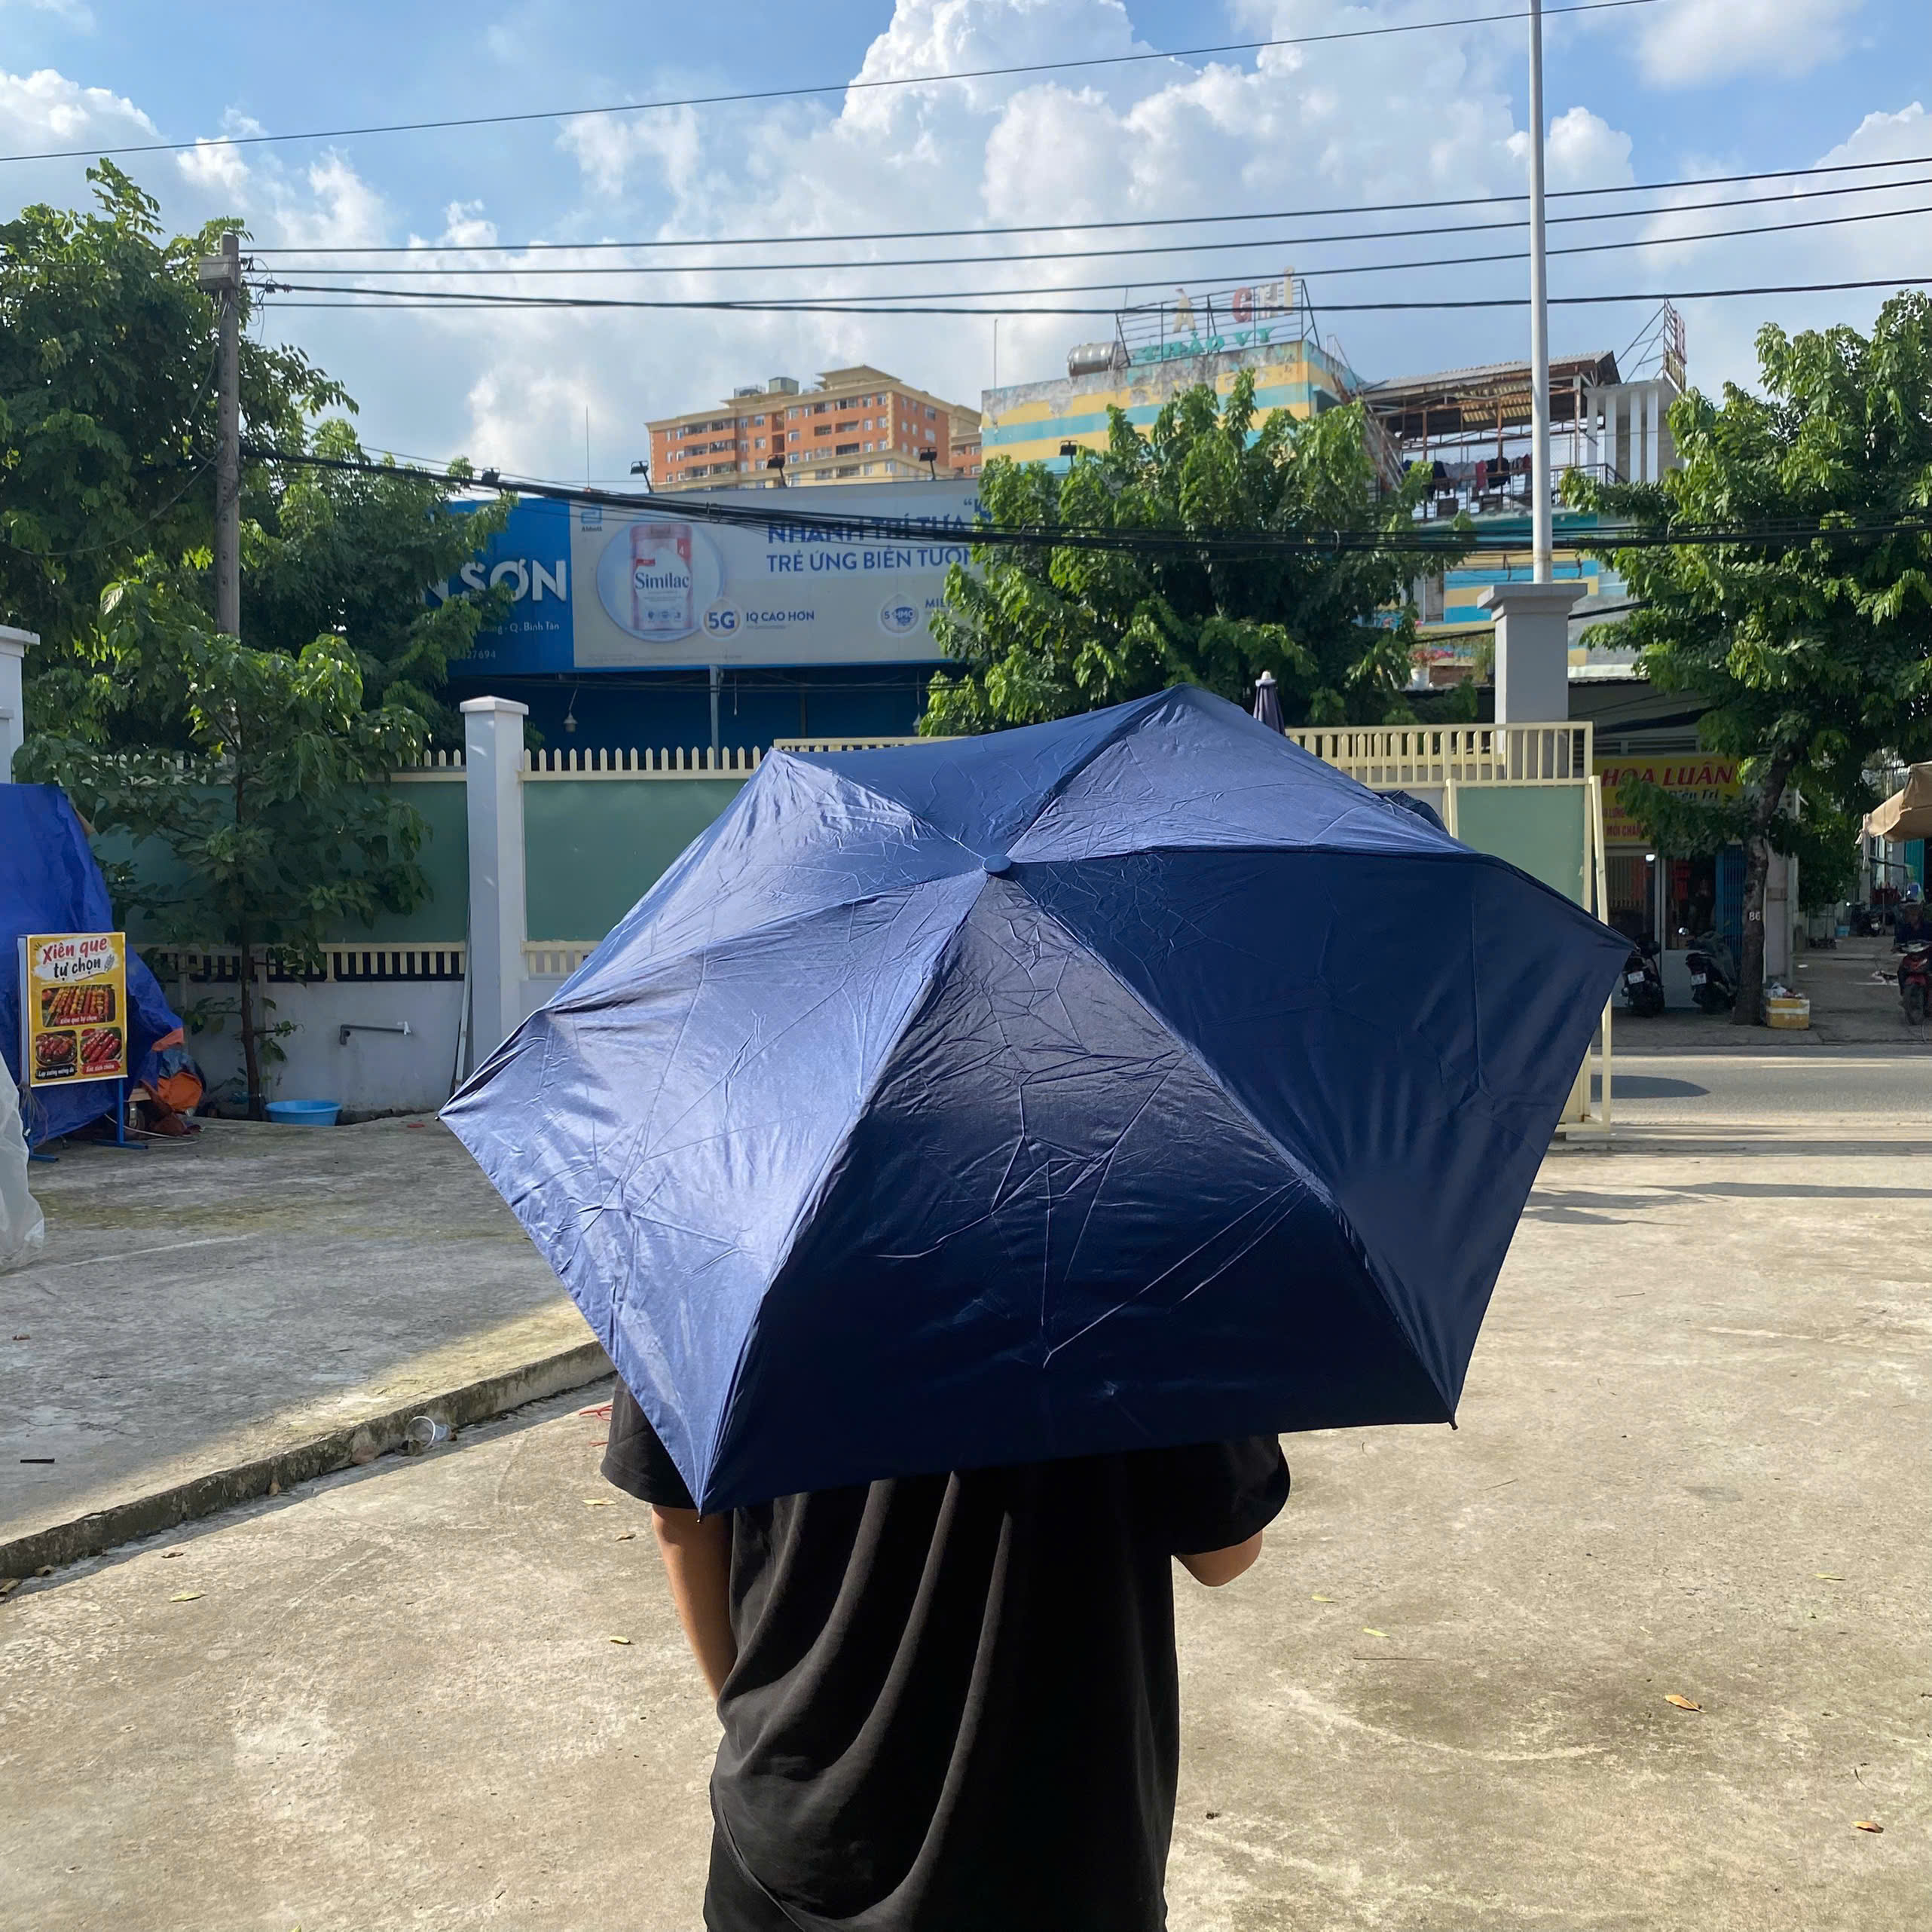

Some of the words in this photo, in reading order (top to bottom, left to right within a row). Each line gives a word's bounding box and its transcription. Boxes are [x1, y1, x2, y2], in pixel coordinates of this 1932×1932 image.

[679, 546, 684, 555] 4
[766, 549, 804, 573] TRẺ
[810, 549, 857, 571] ỨNG
[634, 572, 689, 589] Similac
[708, 611, 735, 630] 5G
[746, 612, 759, 623] IQ
[761, 611, 785, 622] CAO
[1749, 911, 1761, 921] 86
[43, 942, 75, 964] Xiên
[79, 937, 107, 958] que
[54, 961, 69, 981] tự
[72, 957, 101, 974] chọn
